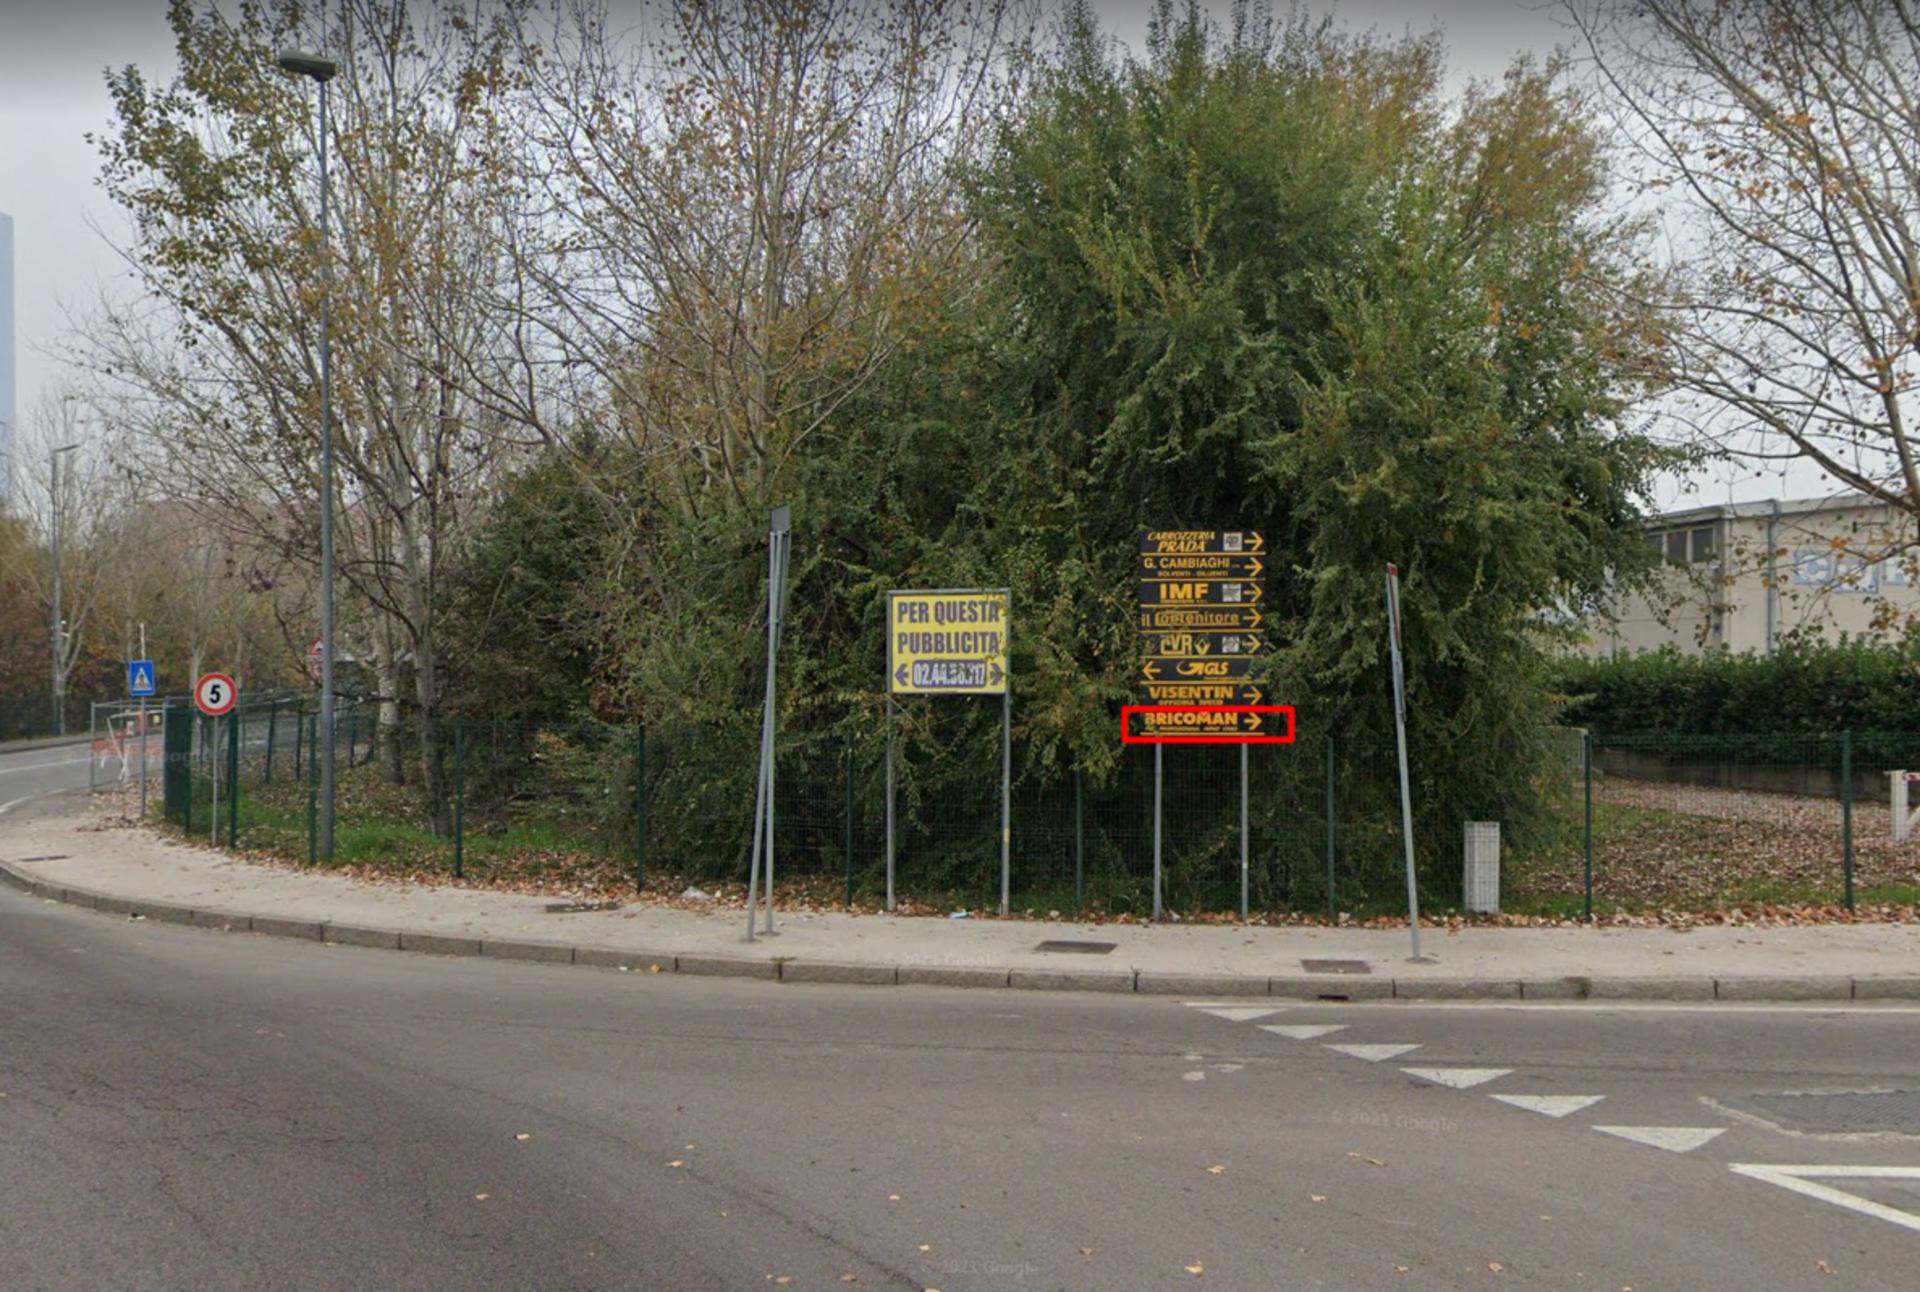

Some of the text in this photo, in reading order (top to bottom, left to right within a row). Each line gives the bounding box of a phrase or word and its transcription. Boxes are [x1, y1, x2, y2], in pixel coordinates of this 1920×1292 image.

[1156, 541, 1206, 552] PRADA
[1159, 557, 1230, 568] CAMBIAGHI
[1160, 583, 1209, 599] IMF
[897, 601, 1000, 625] PER QUESTA
[209, 684, 221, 704] 5
[1148, 686, 1234, 699] VISENTIN
[1144, 712, 1239, 725] BRICOMAN
